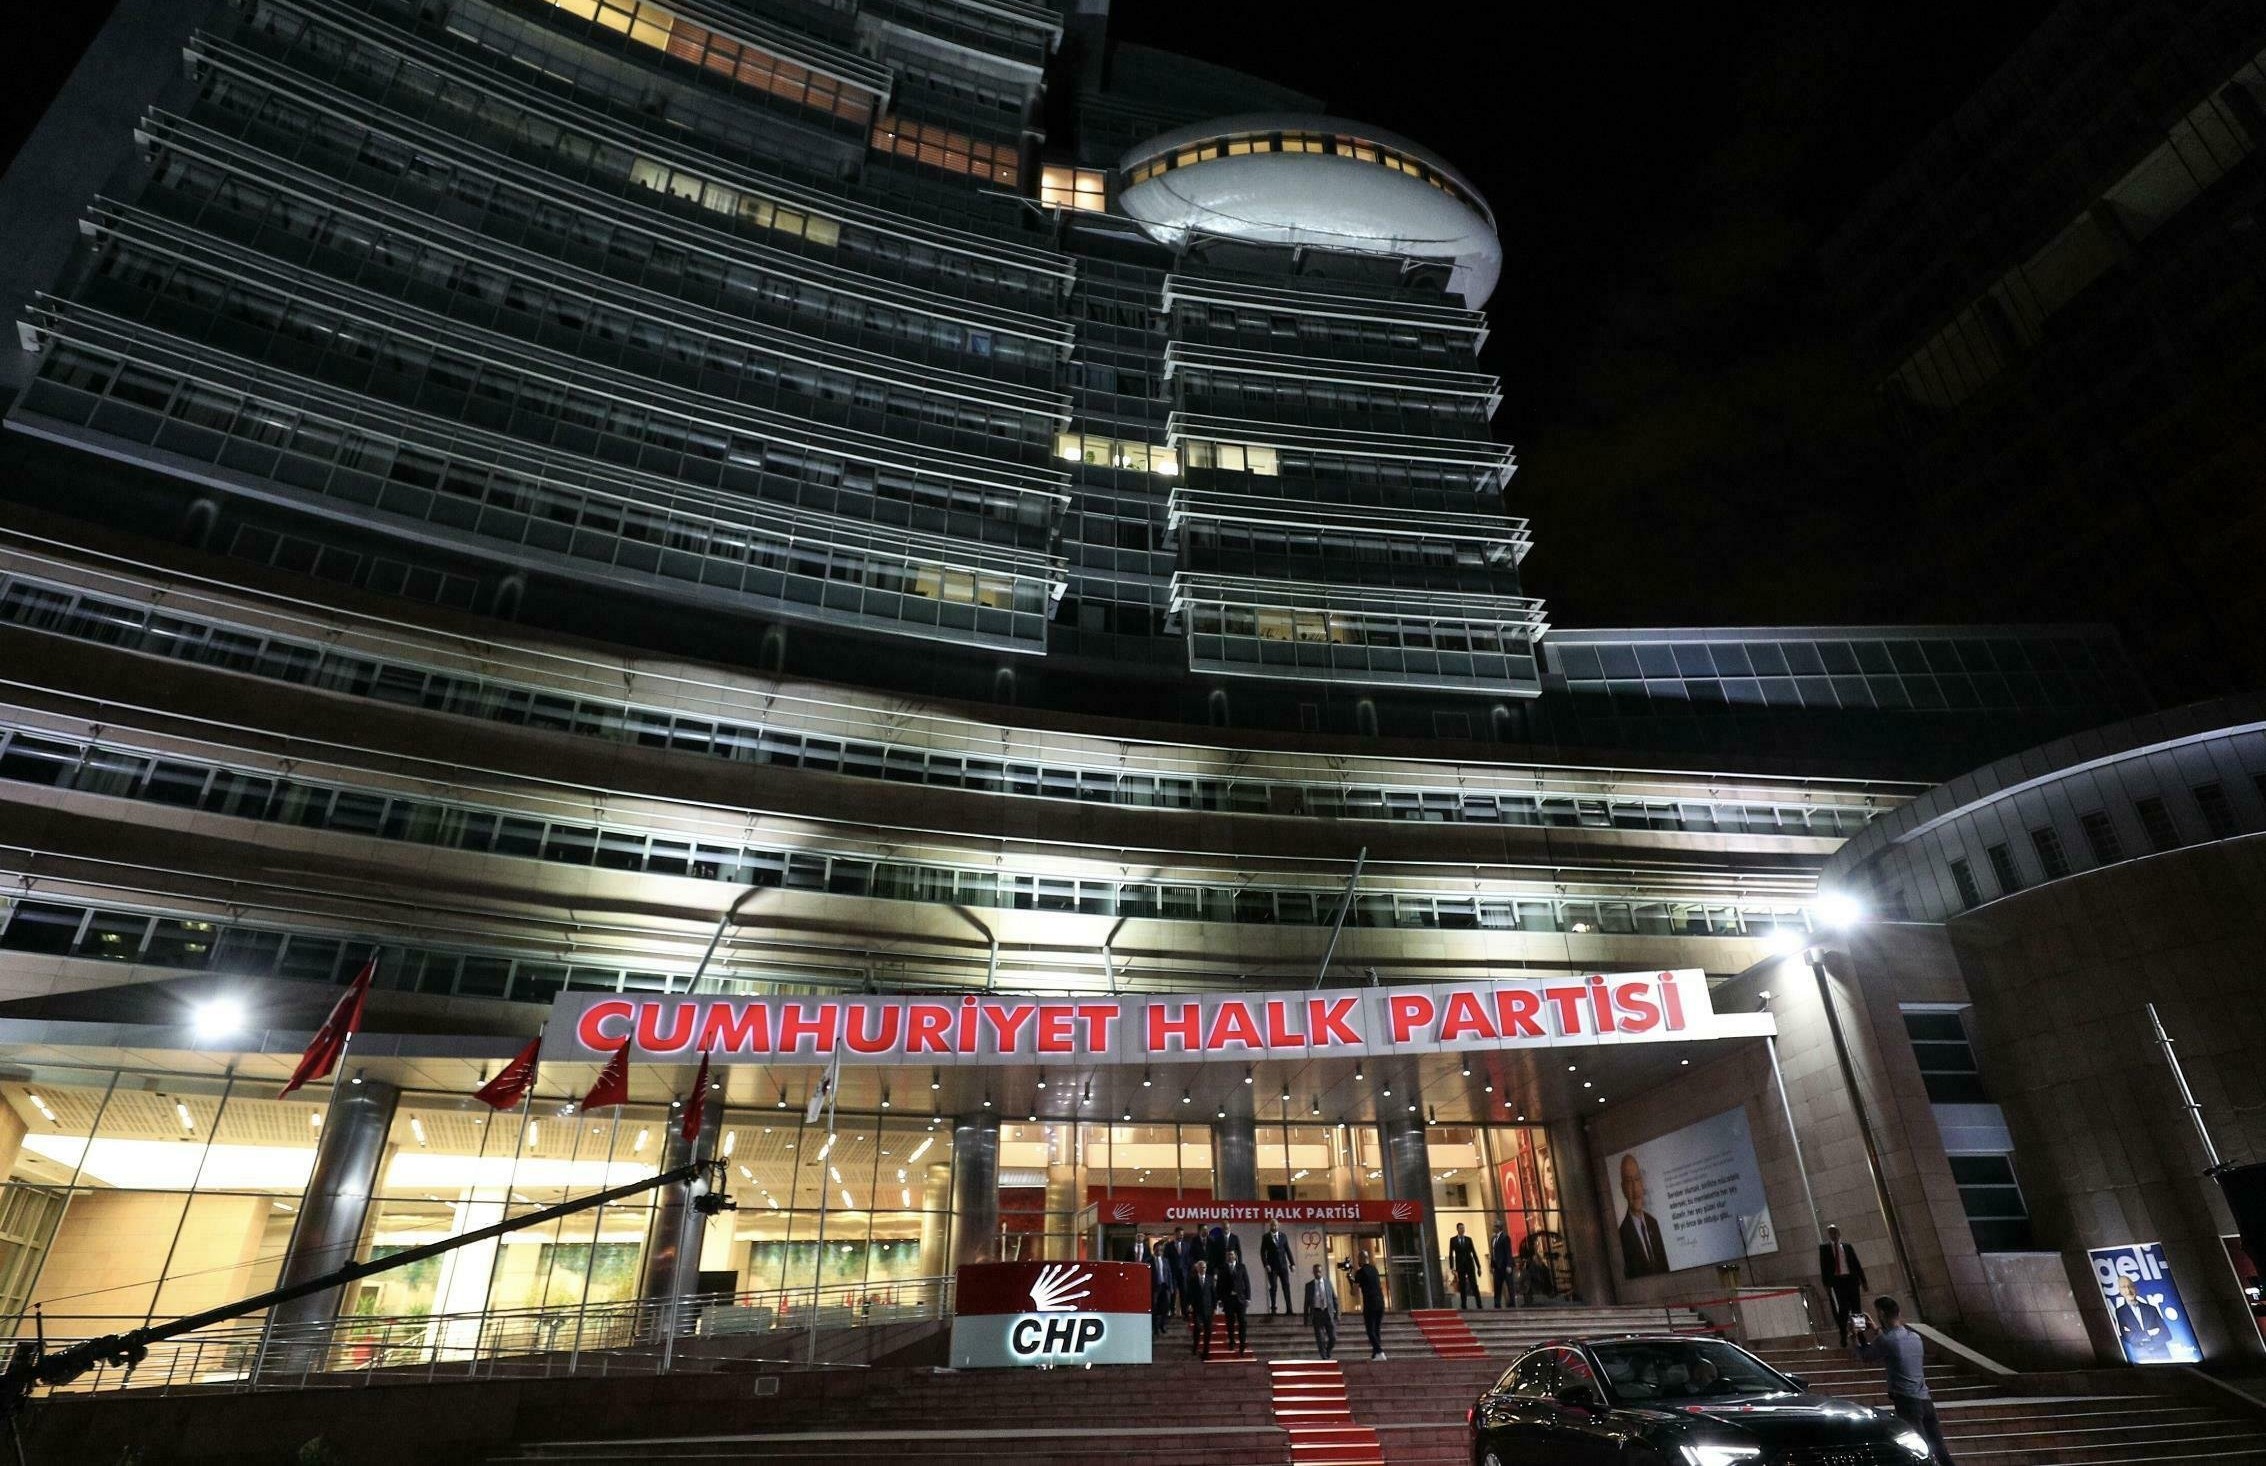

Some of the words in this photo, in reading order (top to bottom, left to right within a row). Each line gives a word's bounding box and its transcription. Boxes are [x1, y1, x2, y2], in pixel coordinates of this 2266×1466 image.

[576, 995, 1120, 1055] CUMHURİYET
[1147, 997, 1363, 1051] HALK
[1388, 972, 1687, 1042] PARTİSİ
[1166, 1204, 1260, 1220] CUMHURİYET
[1264, 1206, 1301, 1219] HALK
[1307, 1204, 1361, 1219] PARTİSİ
[1012, 1318, 1105, 1355] CHP
